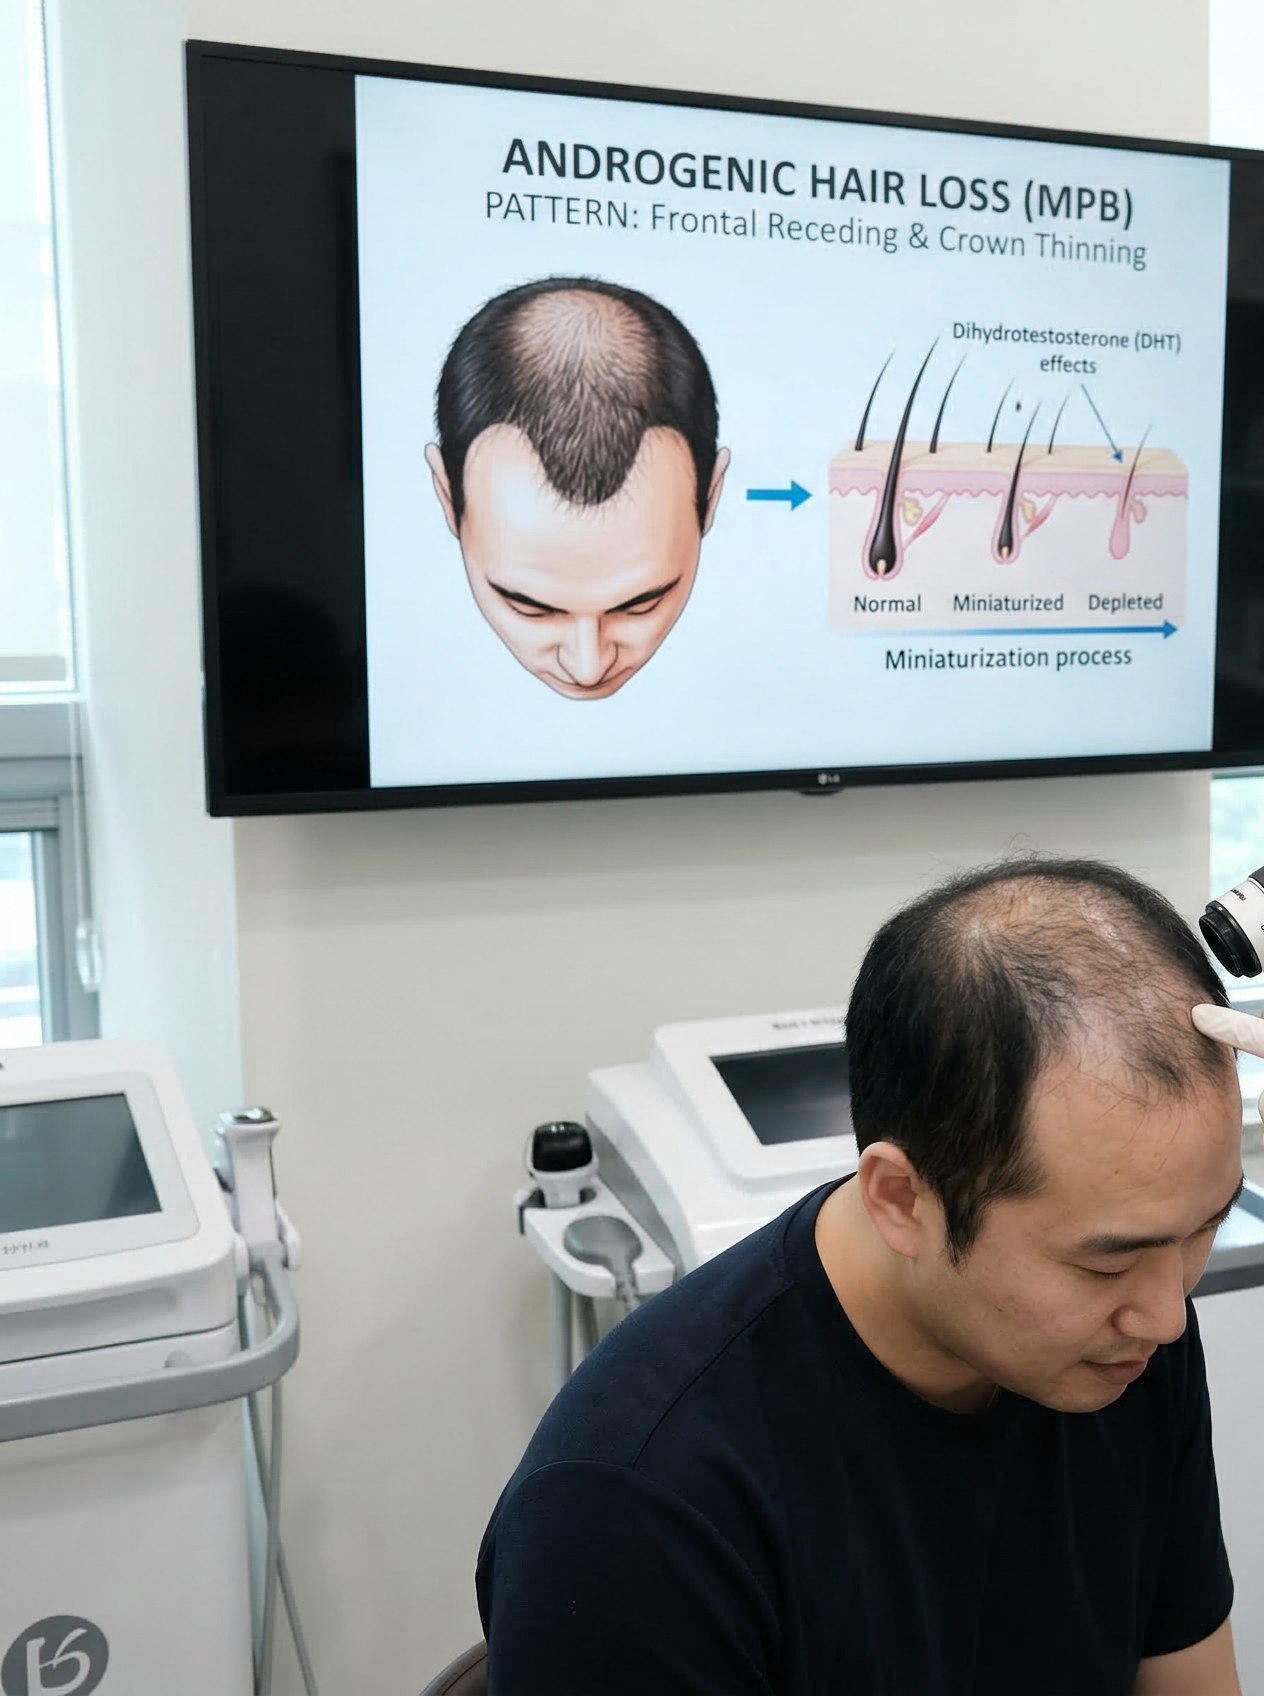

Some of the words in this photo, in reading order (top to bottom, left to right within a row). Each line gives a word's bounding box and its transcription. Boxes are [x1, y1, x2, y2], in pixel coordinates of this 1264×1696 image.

[501, 137, 796, 196] ANDROGENIC
[810, 163, 906, 206] HAIR
[920, 173, 1011, 214] LOSS
[1024, 179, 1133, 230] (MPB)
[486, 191, 638, 229] PATTERN:
[651, 203, 756, 238] Frontal
[768, 211, 899, 255] Receding
[908, 221, 930, 250] &
[939, 225, 1025, 257] Crown
[1033, 232, 1148, 272] Thinning
[952, 321, 1130, 349] Dihydrotestosterone
[1133, 330, 1182, 355] (DHT)
[1039, 353, 1098, 375] effects
[853, 593, 922, 614] Normal
[953, 593, 1065, 613] Miniaturized
[1088, 592, 1164, 615] Depleted
[885, 647, 1049, 671] Miniaturization
[1055, 649, 1133, 672] process
